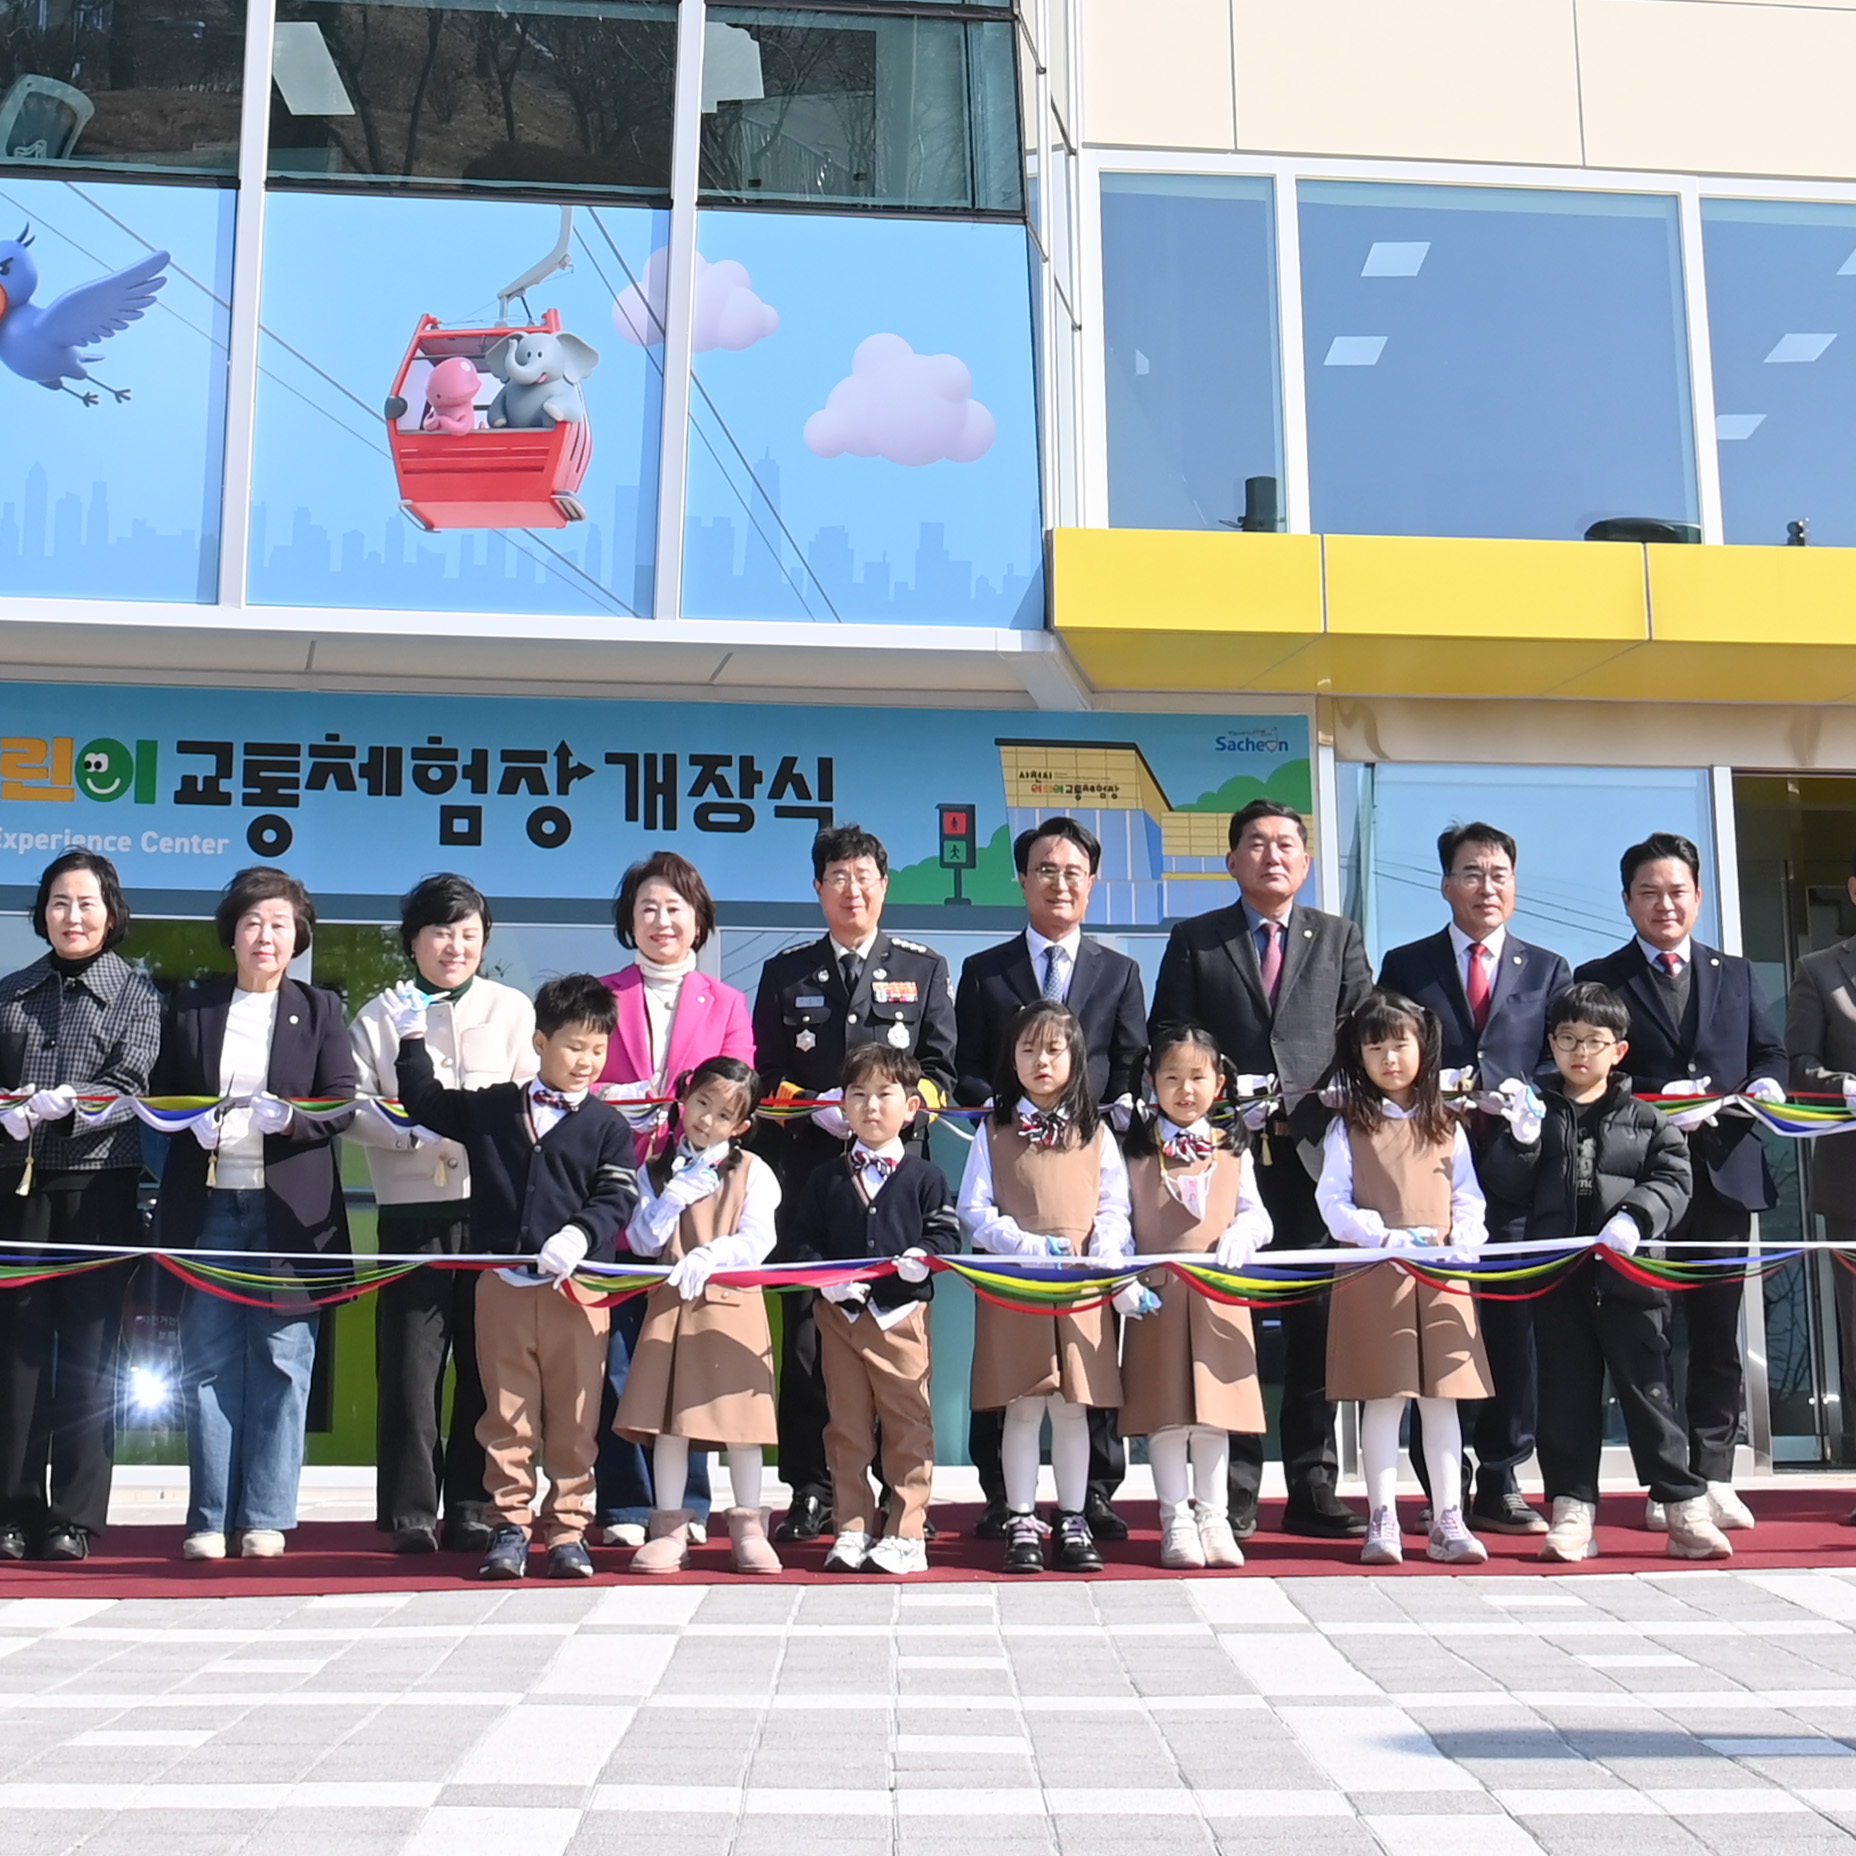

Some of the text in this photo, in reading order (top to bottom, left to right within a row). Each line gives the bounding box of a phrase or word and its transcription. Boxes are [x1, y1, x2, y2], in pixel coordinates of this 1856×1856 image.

[1215, 735, 1289, 752] Sacheon
[604, 752, 834, 836] 개장식
[140, 830, 230, 855] Center
